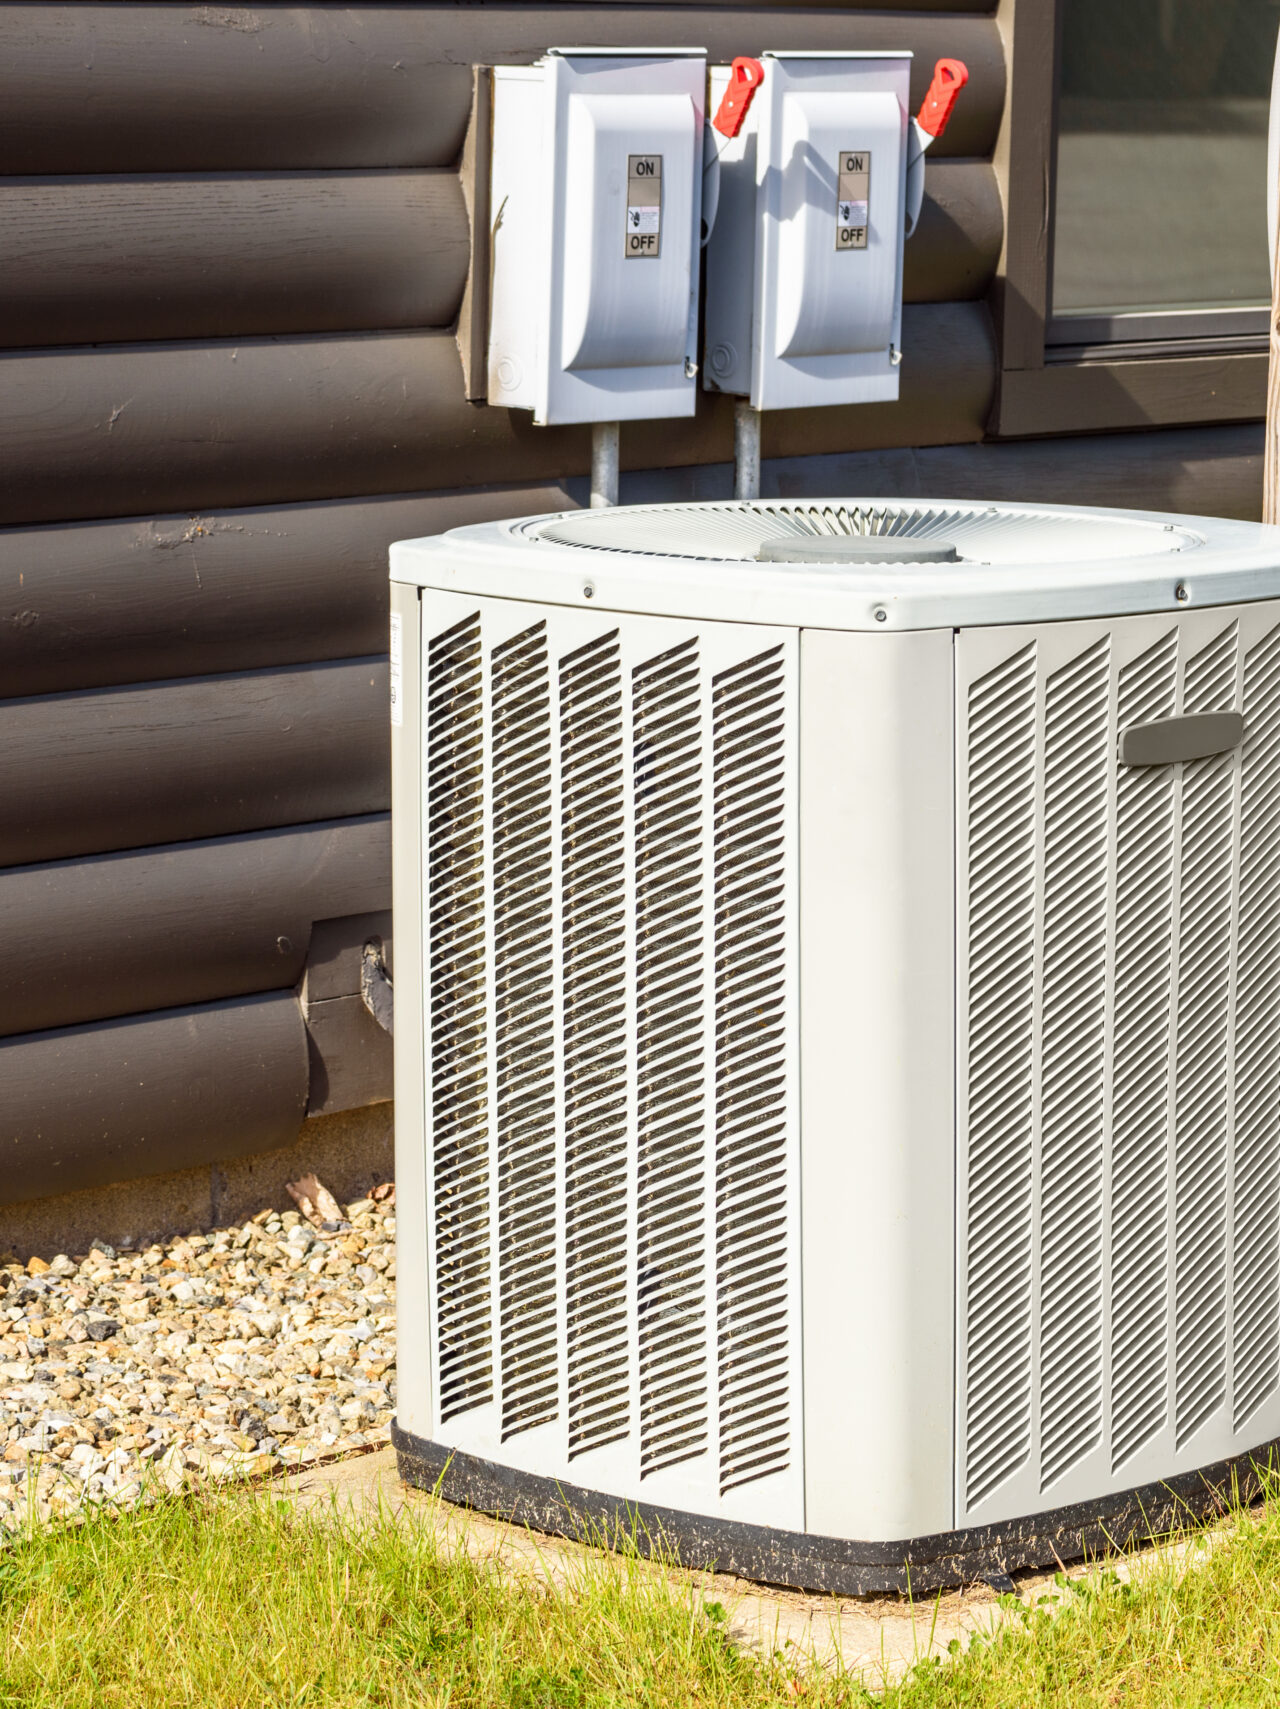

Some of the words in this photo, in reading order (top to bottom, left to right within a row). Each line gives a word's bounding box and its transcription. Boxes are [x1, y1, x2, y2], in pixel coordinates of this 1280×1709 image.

[636, 162, 654, 176] ON
[847, 158, 863, 171] ON
[841, 229, 863, 242] OFF
[631, 236, 655, 249] OFF
